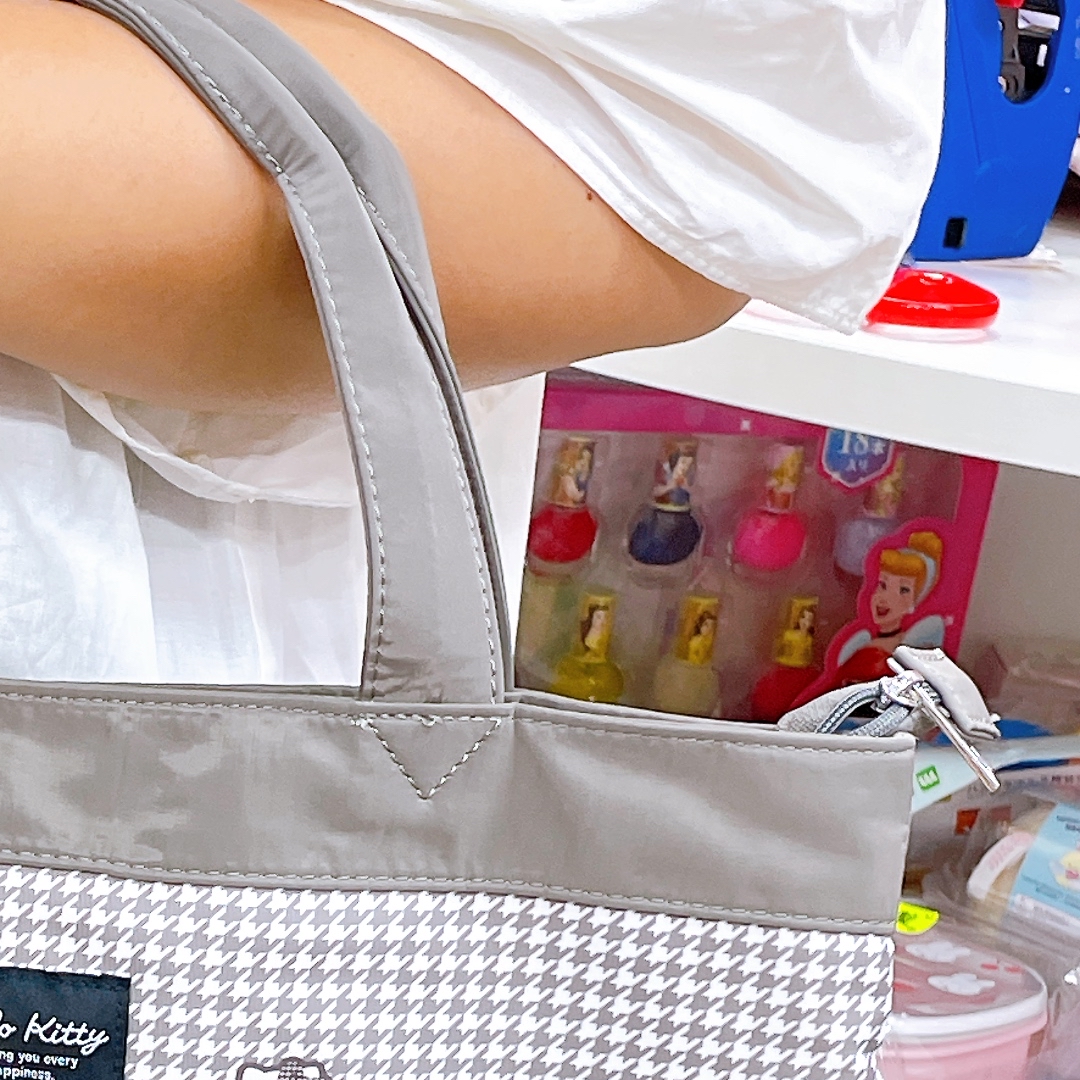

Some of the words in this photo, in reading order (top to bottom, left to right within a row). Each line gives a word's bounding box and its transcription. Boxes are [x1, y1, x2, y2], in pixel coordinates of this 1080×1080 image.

[23, 1013, 110, 1056] Kitty
[17, 1052, 41, 1065] you
[43, 1055, 79, 1069] every
